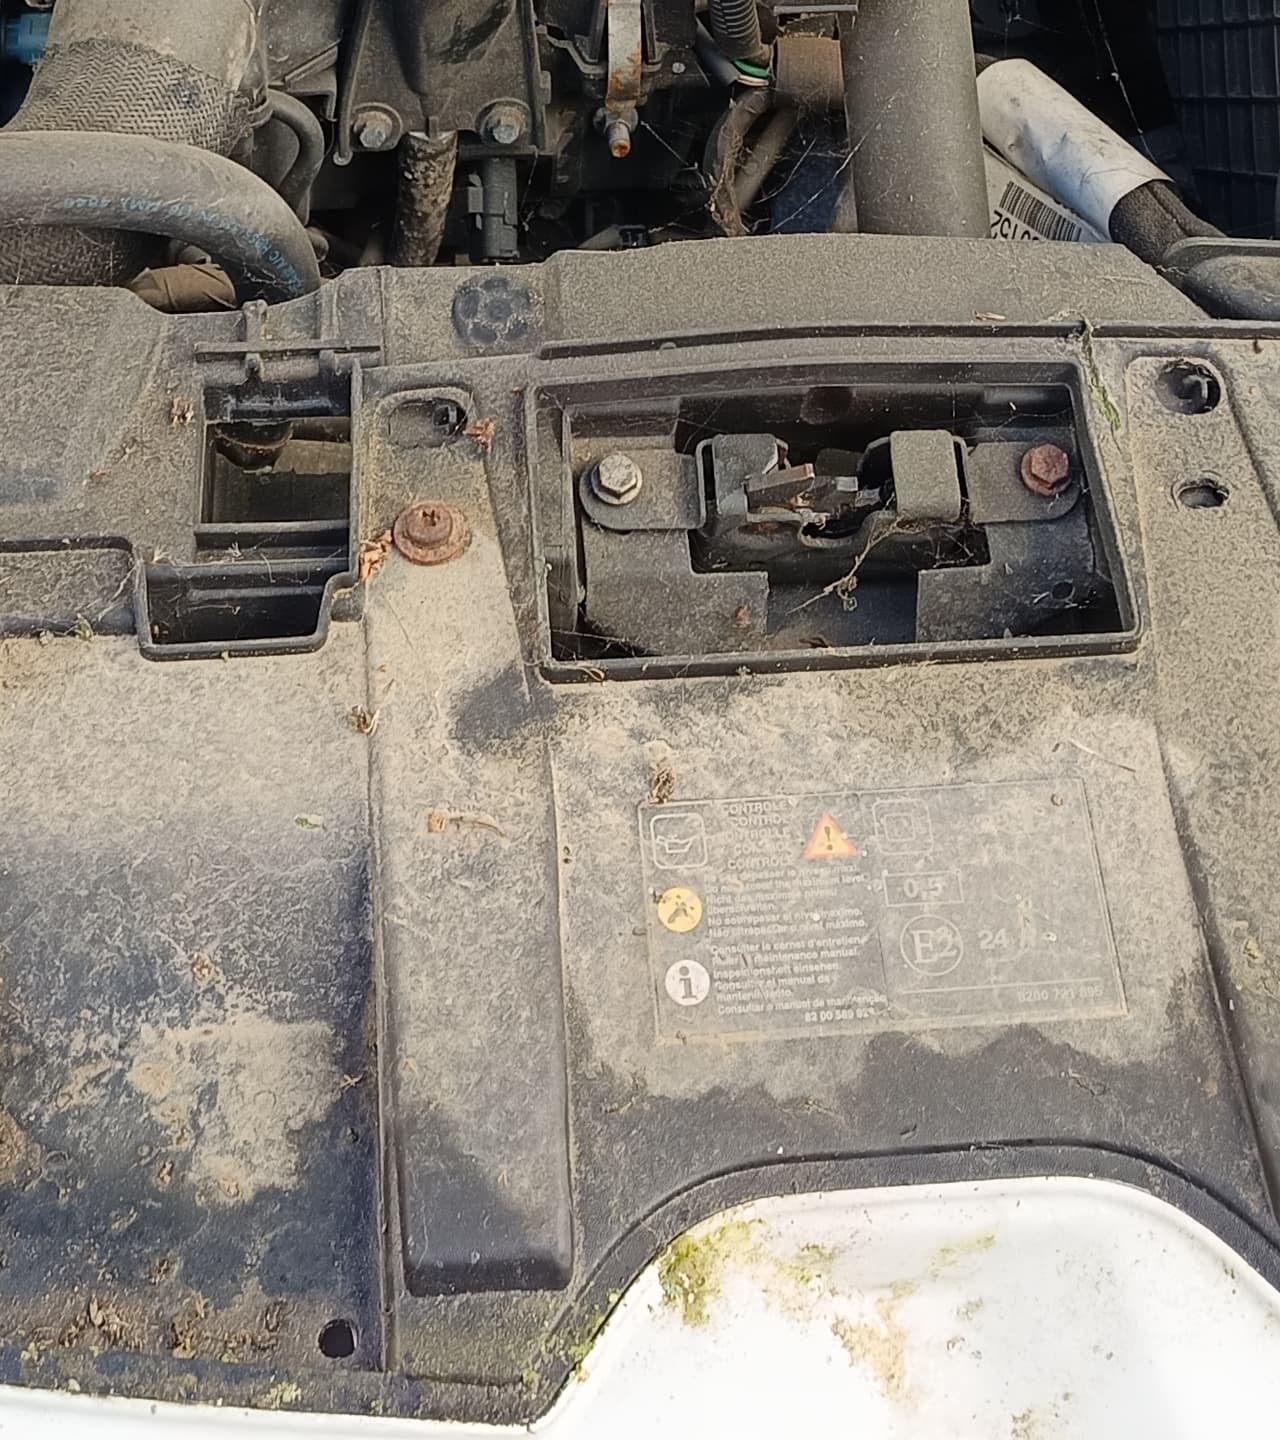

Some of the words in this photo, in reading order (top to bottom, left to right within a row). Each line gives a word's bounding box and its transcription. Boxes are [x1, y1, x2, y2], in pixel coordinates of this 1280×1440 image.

[903, 877, 945, 901] 0,5
[909, 925, 958, 965] E2
[977, 927, 1010, 951] 24
